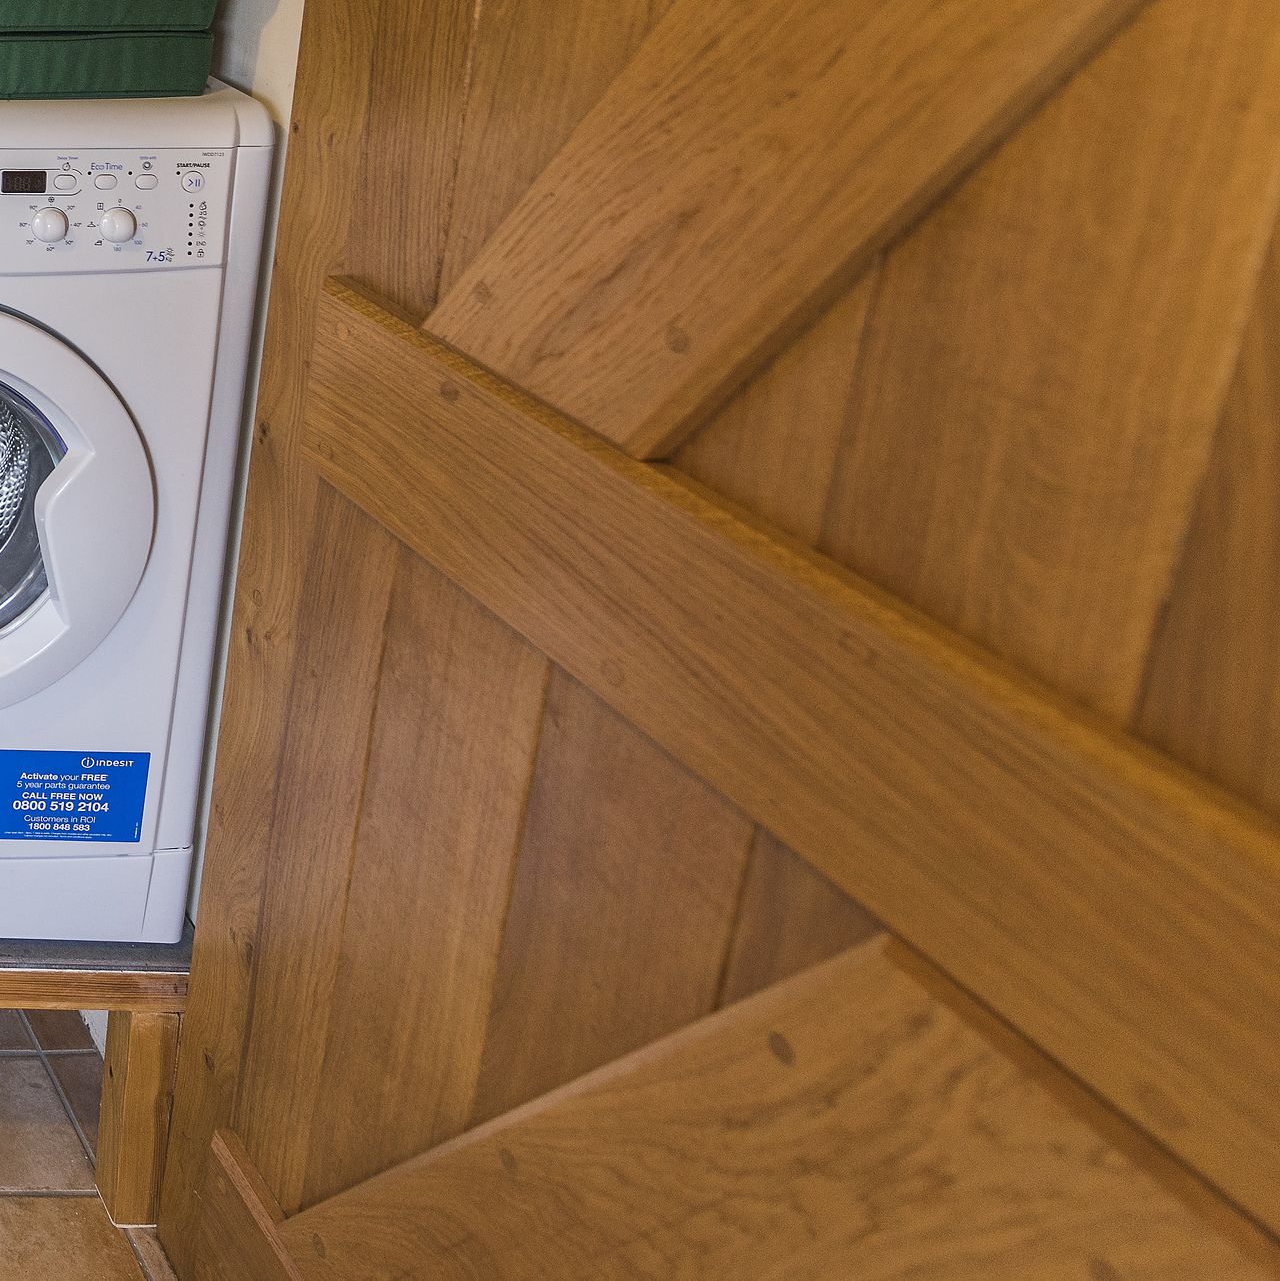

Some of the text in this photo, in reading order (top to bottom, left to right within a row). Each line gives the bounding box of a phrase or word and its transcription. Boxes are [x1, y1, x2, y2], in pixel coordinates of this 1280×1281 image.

[20, 772, 59, 780] Activate
[60, 774, 79, 782] your
[24, 781, 42, 789] year
[44, 781, 66, 789] parts
[22, 792, 104, 801] CALL FREE NOW
[12, 800, 109, 812] 0800 519 2104
[23, 815, 69, 823] Customers
[71, 815, 78, 823] in
[53, 823, 71, 831] 848
